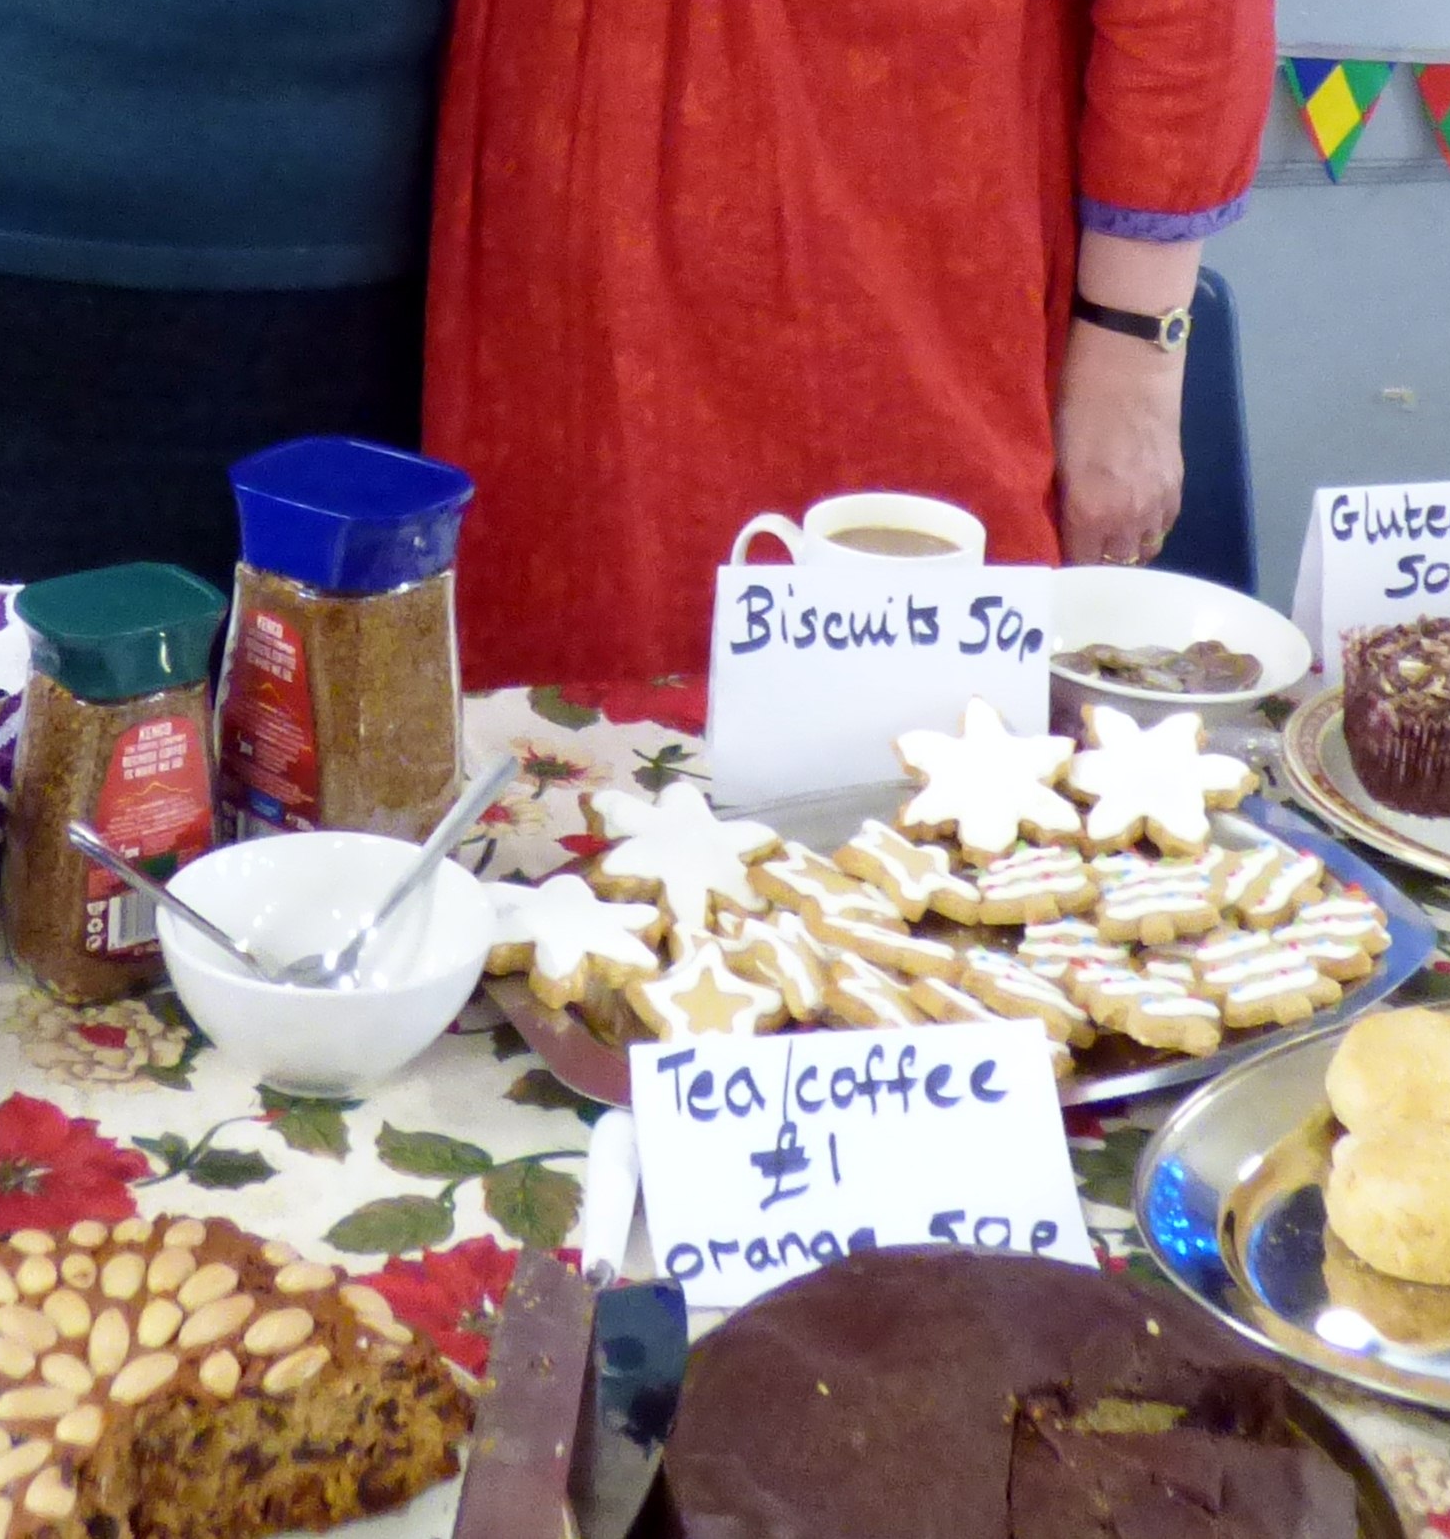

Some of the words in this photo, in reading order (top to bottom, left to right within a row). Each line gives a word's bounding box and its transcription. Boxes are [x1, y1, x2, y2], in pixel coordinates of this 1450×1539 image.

[730, 583, 940, 655] Biscuits
[958, 596, 1044, 663] 50p
[750, 1121, 841, 1210] £1
